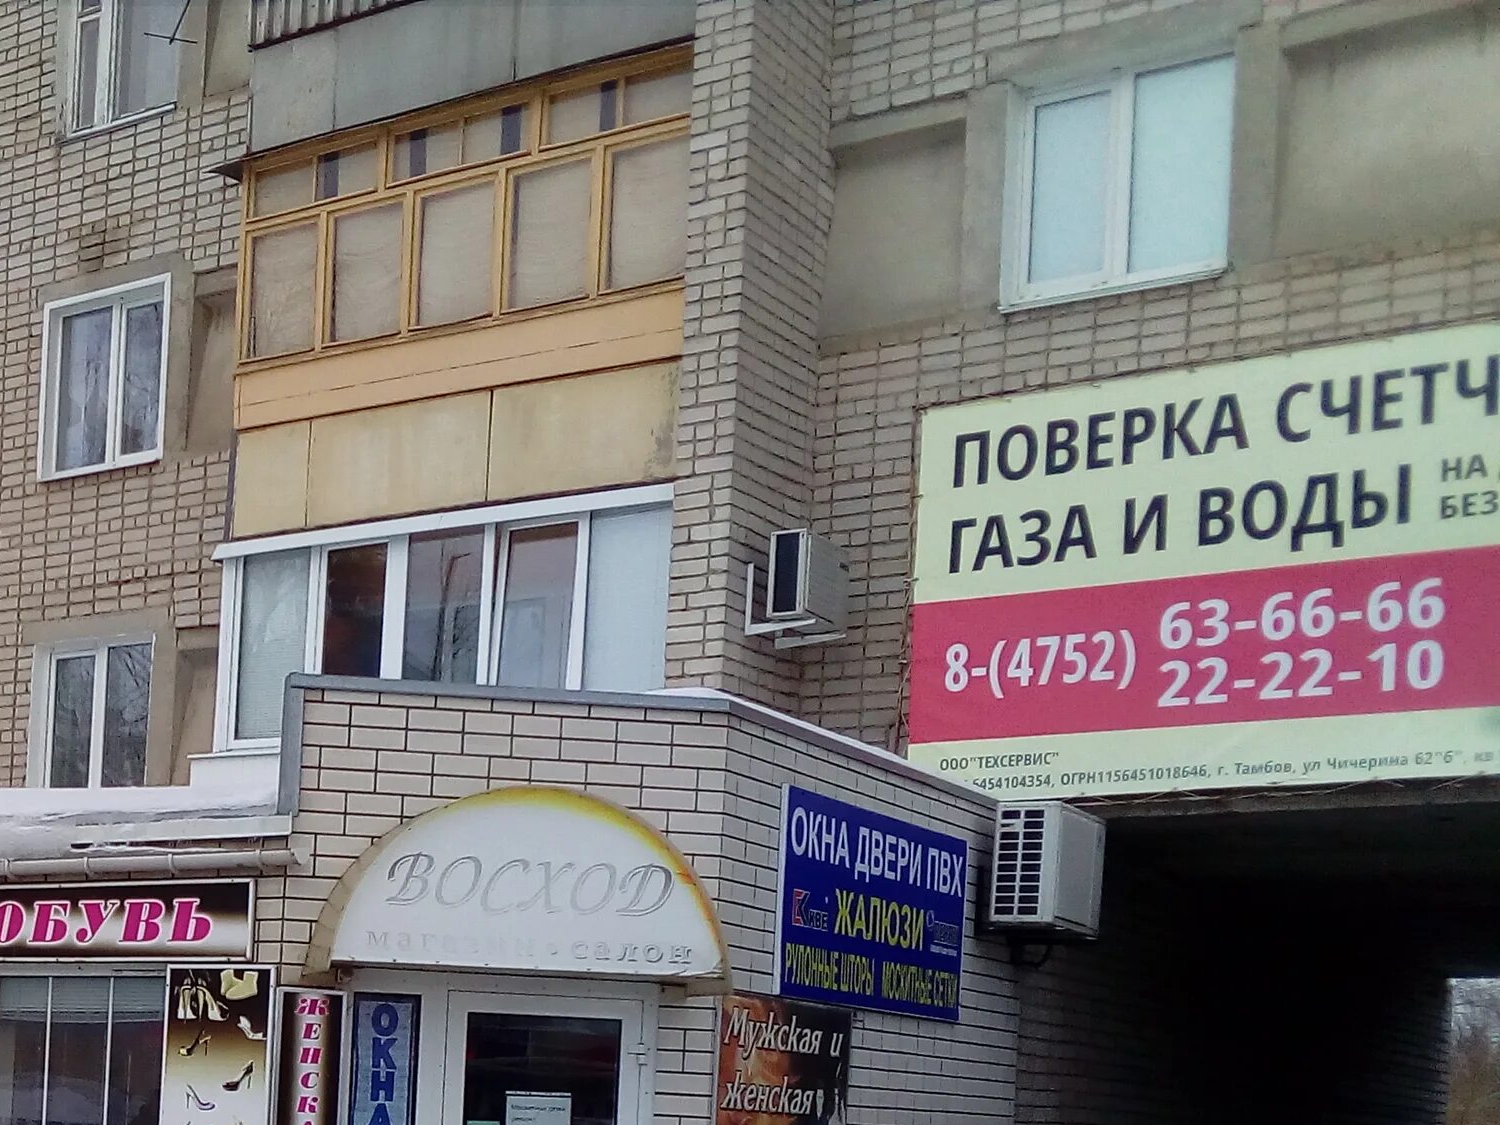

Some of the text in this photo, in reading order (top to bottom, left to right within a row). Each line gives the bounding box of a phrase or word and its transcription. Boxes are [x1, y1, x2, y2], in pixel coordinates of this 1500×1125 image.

[952, 355, 1500, 488] ПОВЕРКА СЧЕТЧ
[1440, 454, 1489, 482] НА
[948, 463, 1412, 574] ГАЗА И ВОДЫ
[1440, 490, 1500, 520] БЕЗ
[1159, 577, 1445, 650] 63-66-66
[944, 629, 1137, 699] 8-(4752)
[1156, 639, 1444, 709] 22-22-10
[1217, 766, 1230, 776] г.
[1234, 760, 1297, 776] Тамбов,
[1302, 760, 1321, 776] ул
[1327, 754, 1408, 770] Чичерина
[790, 806, 964, 898] ОКНА ДВЕРИ ПВХ
[834, 888, 925, 951] ЖАЛЮЗИ
[571, 940, 693, 965] салон
[784, 942, 839, 991] РУЛОННЫЕ
[840, 952, 875, 996] ШТОРЫ
[722, 1006, 844, 1061] Мужская и
[720, 1070, 815, 1116] женская
